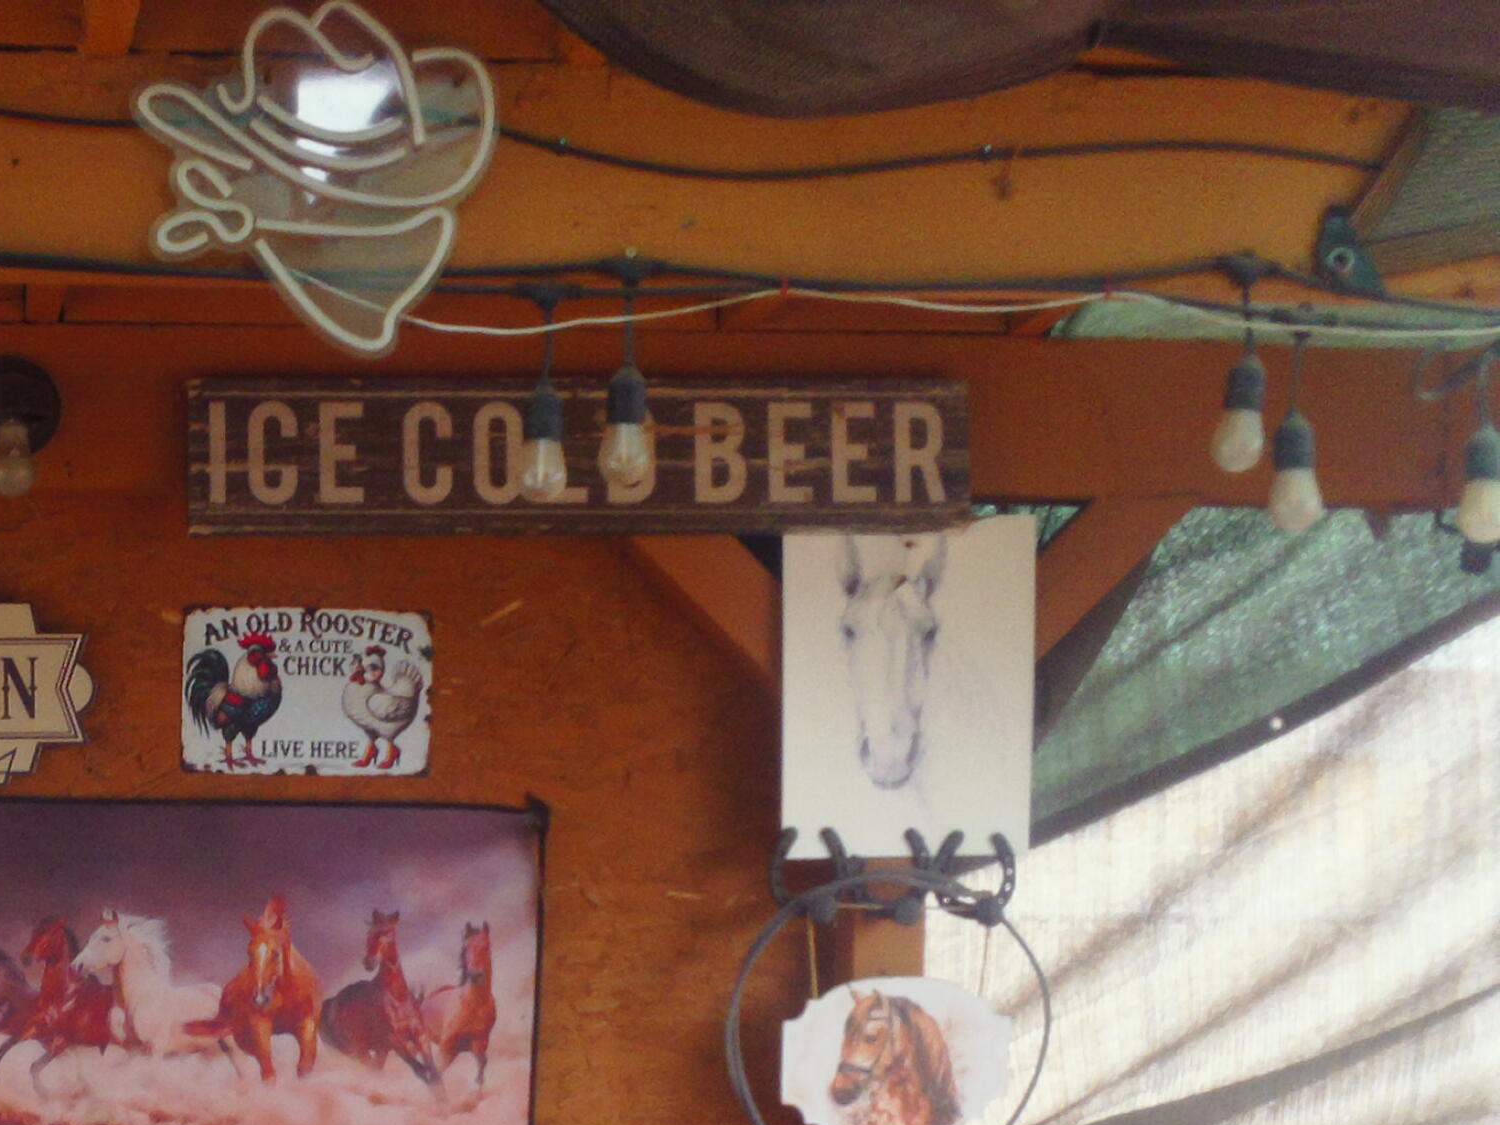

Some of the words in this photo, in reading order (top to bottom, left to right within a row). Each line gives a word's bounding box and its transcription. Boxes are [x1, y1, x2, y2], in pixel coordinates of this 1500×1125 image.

[208, 401, 365, 505] ICE
[694, 401, 947, 504] BEER
[204, 616, 239, 646] AN
[245, 612, 293, 634] OLD
[300, 611, 415, 655] ROOSTER
[278, 640, 291, 653] &
[294, 640, 304, 653] A
[309, 639, 353, 655] CUTE
[283, 656, 347, 677] CHICK
[261, 740, 304, 758] LIVE
[310, 741, 360, 760] HERE
